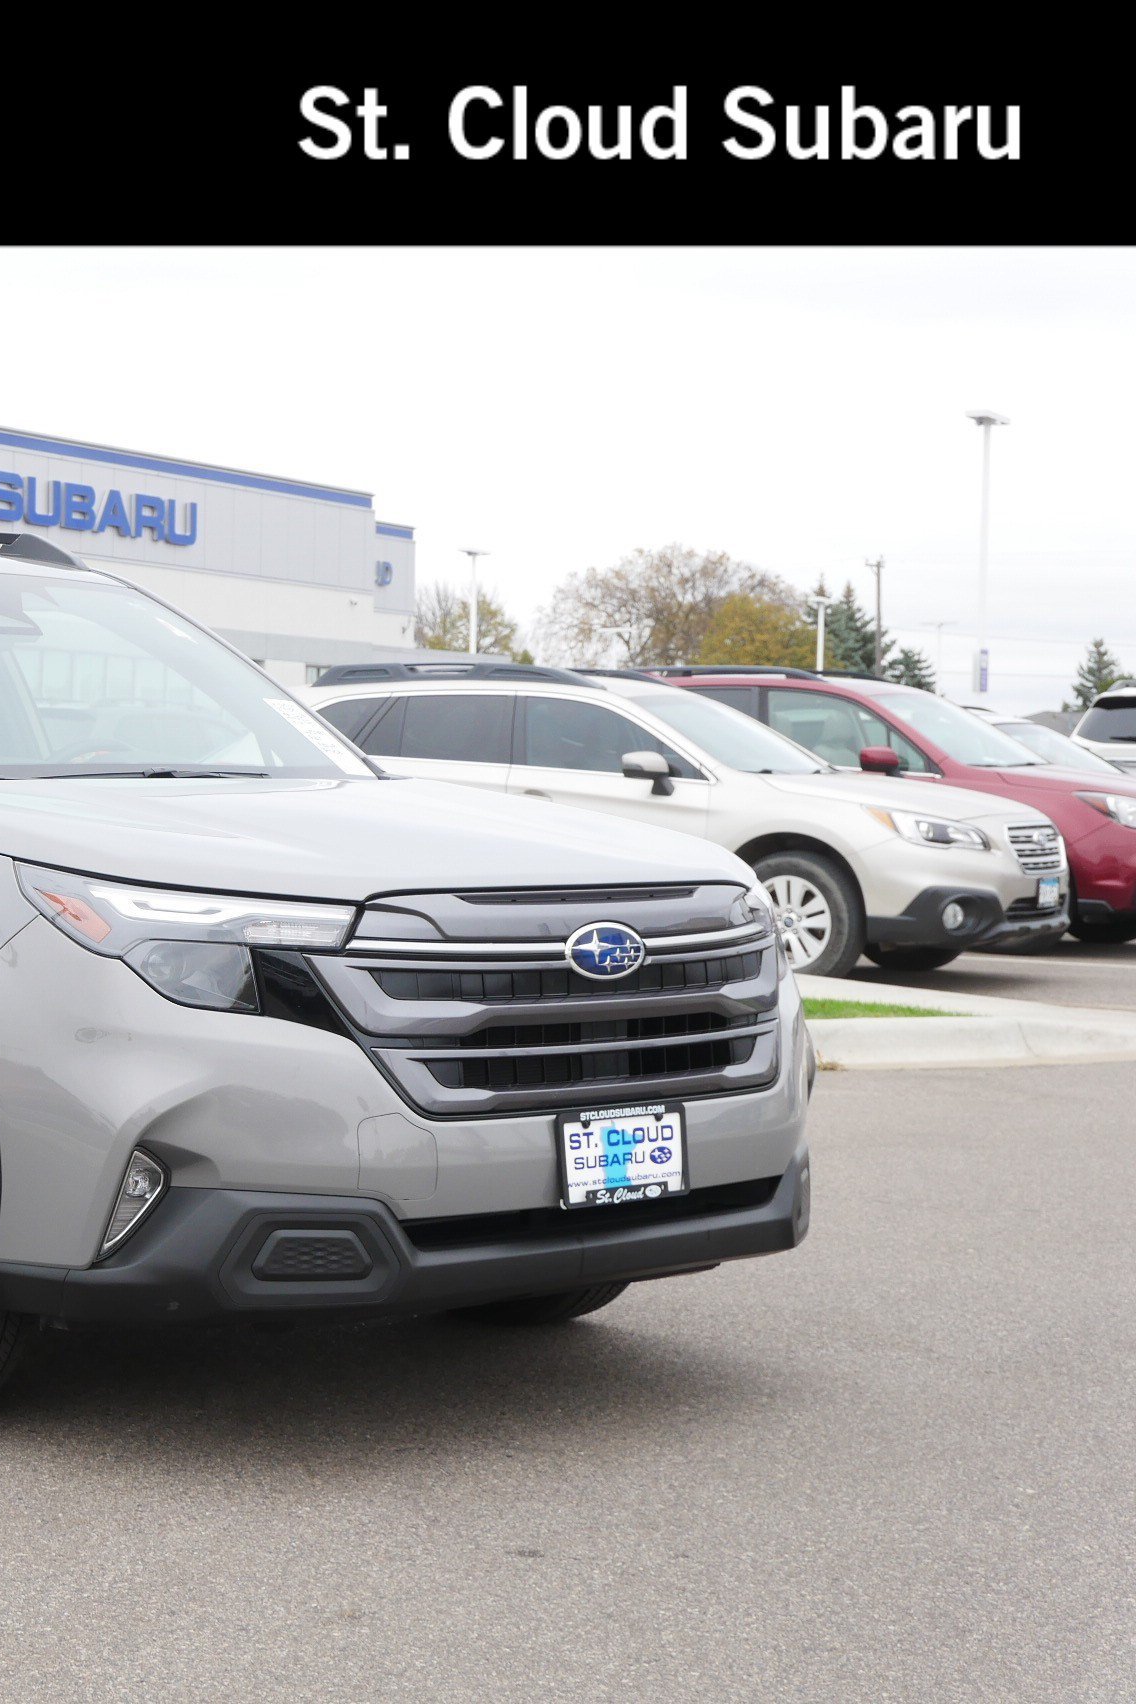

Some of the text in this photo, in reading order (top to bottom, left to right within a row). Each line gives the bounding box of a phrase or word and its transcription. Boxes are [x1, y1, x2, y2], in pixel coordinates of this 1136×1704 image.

[580, 1105, 665, 1121] STCLOUDSUBARU.COM
[569, 1125, 674, 1151] ST. CLOUD
[574, 1151, 645, 1170] SUBARU
[568, 1171, 681, 1188] www.stcloudsubaru.com
[596, 1187, 644, 1204] St. Cloud
